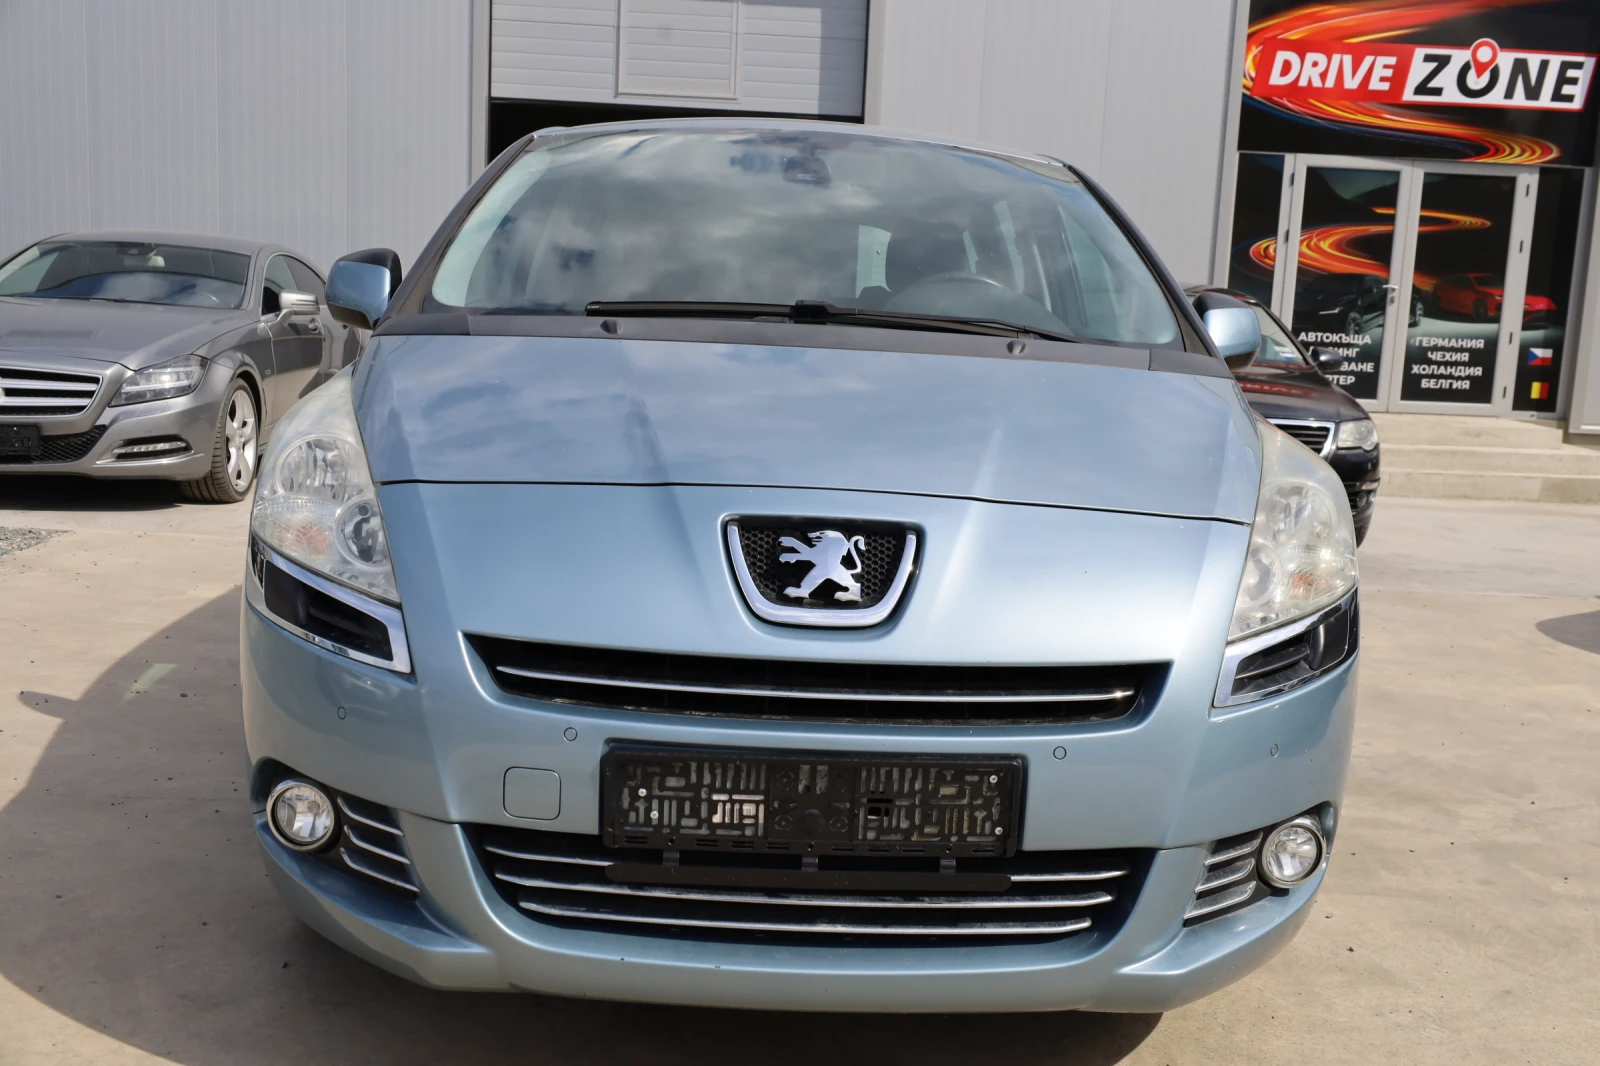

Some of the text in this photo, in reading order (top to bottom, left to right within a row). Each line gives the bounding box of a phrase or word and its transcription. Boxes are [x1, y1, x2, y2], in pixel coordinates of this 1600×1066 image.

[1268, 50, 1586, 104] DRIVE ZONE
[1297, 331, 1372, 346] АВТОКЪЩА
[1415, 336, 1485, 349] ГЕРМАНИЯ
[1427, 351, 1470, 362] ЧЕХИЯ
[1410, 364, 1483, 377] ХОЛАНДИЯ
[1420, 378, 1471, 390] БЕЛГИЯ
